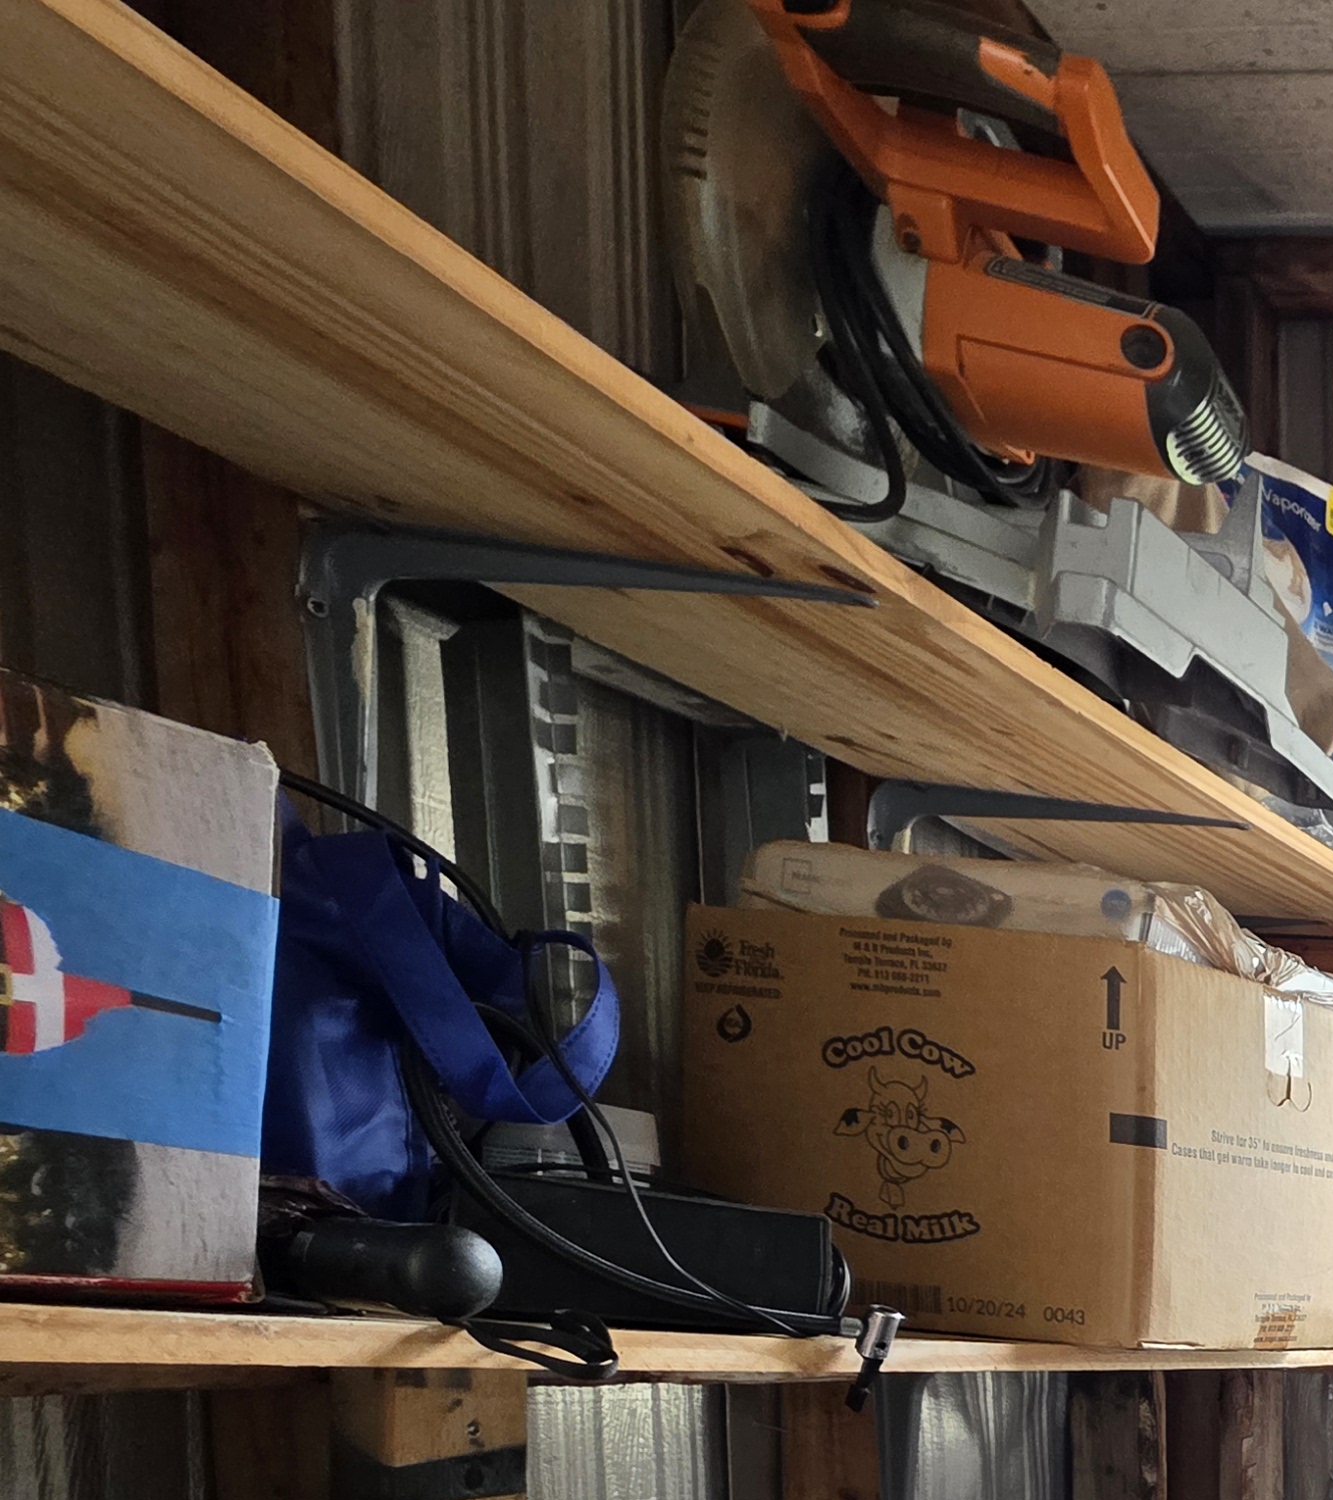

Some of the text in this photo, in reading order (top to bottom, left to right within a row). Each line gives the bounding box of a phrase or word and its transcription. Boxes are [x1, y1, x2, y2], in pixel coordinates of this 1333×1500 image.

[823, 1027, 975, 1078] Cool Cow
[1102, 1032, 1127, 1050] UP
[1171, 1142, 1198, 1159] Cases
[1199, 1147, 1215, 1162] that
[1216, 1151, 1230, 1165] get
[1231, 1154, 1252, 1167] warm
[824, 1192, 981, 1243] Real Milk
[1043, 1307, 1086, 1325] 0043
